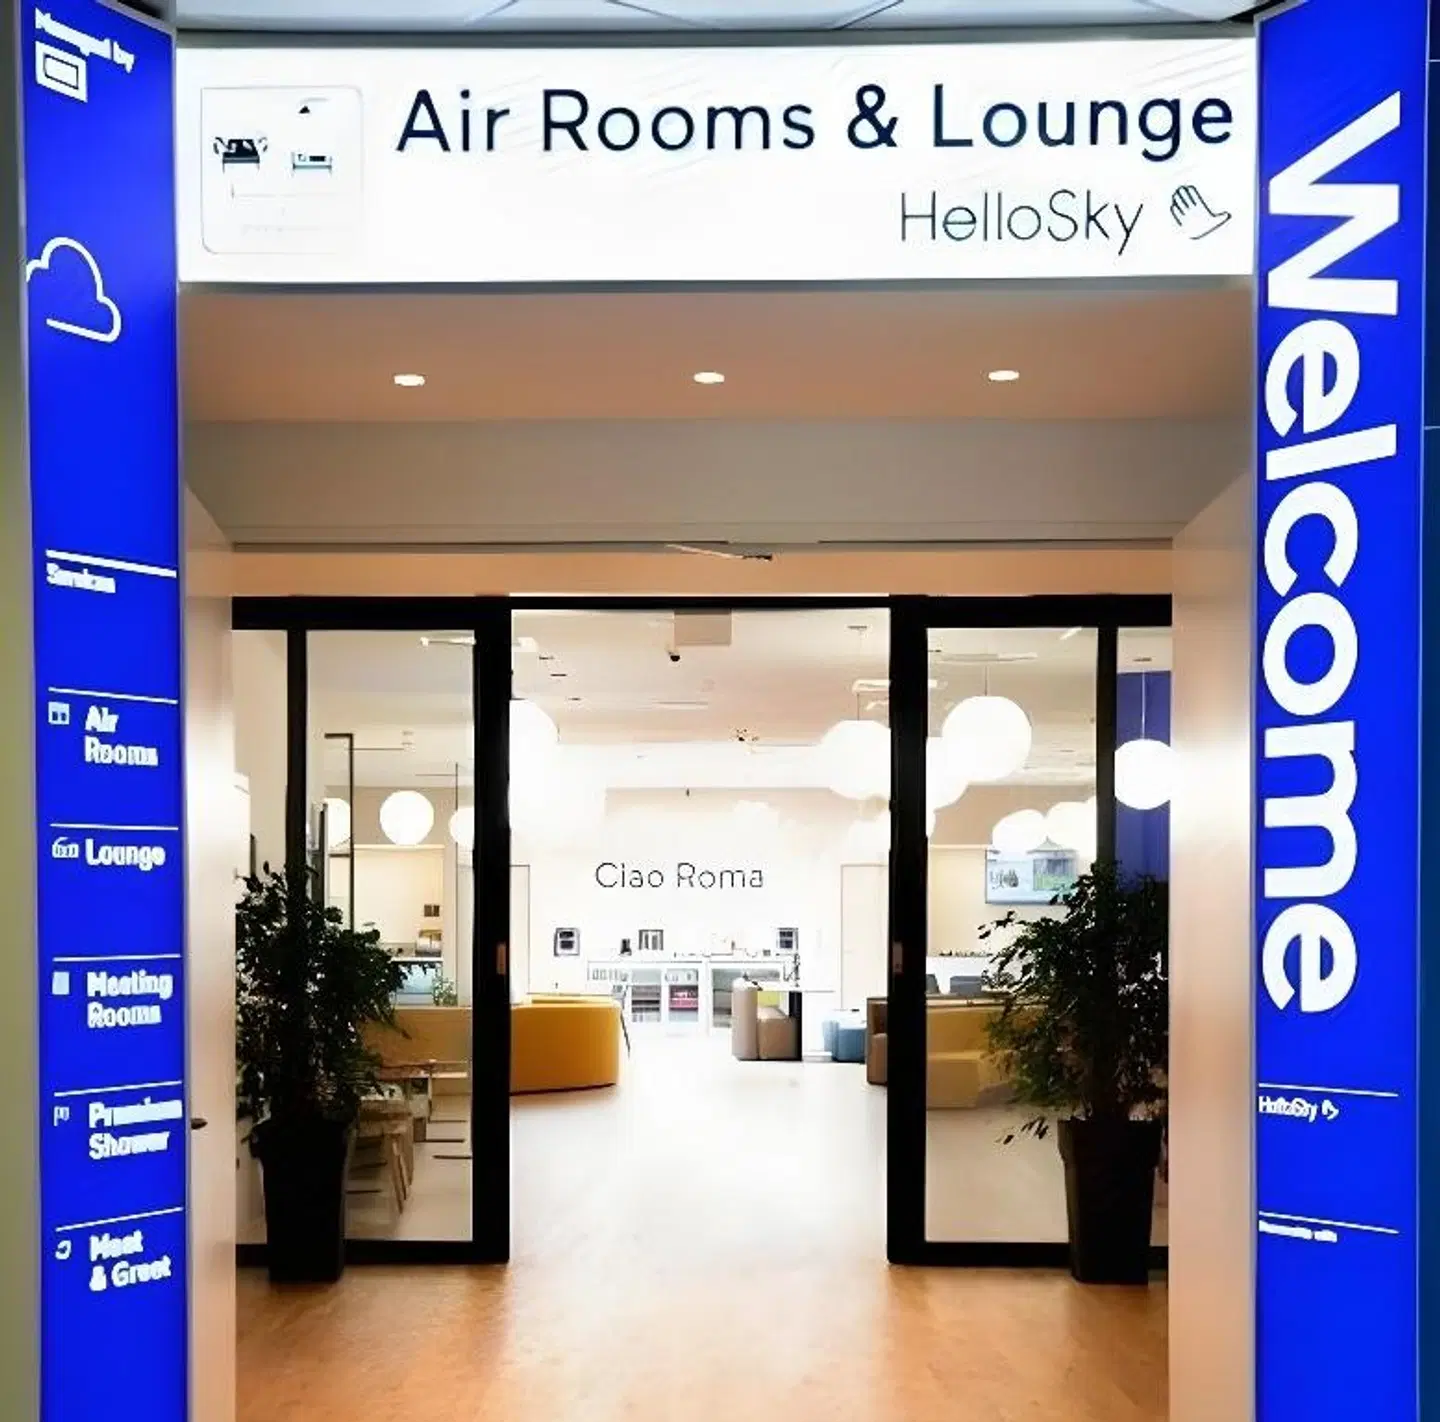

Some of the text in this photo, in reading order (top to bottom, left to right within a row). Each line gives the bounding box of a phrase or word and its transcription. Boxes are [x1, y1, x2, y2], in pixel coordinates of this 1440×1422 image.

[396, 84, 1233, 162] Air Rooms & Lounge
[901, 189, 1144, 256] HelloSky
[1262, 91, 1401, 1012] Welcome
[85, 735, 159, 767] Rooms
[85, 838, 166, 871] Lounge
[595, 862, 763, 889] Ciao Roma
[87, 1002, 162, 1028] Rooms
